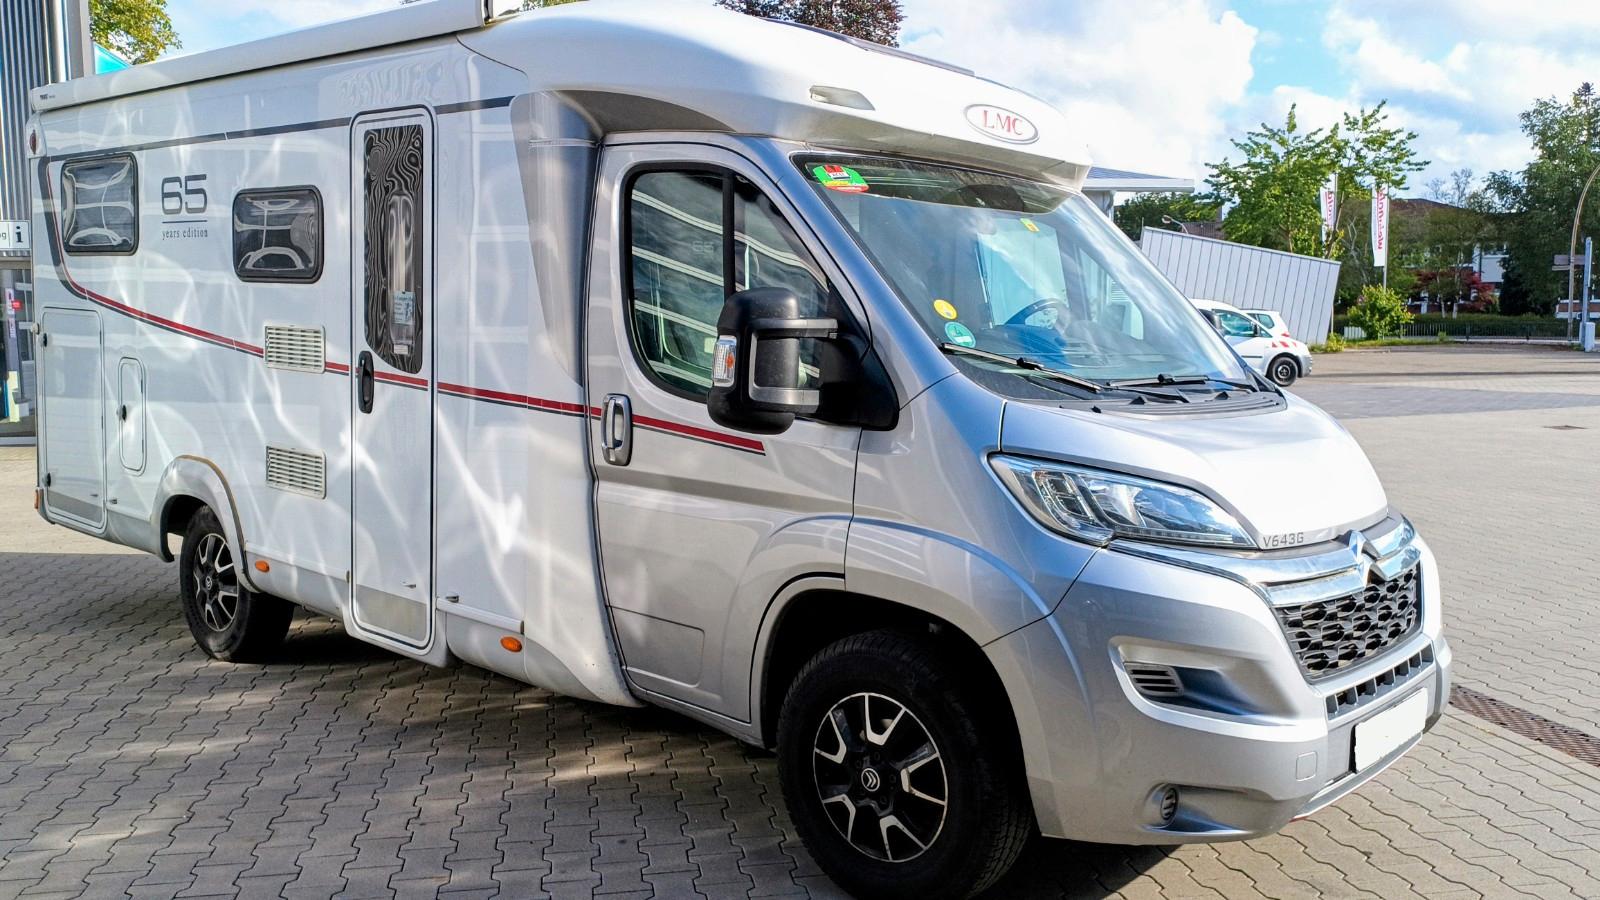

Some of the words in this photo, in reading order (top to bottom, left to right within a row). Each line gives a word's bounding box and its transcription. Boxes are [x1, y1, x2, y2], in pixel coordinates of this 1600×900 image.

[983, 109, 1023, 136] LMC
[161, 174, 208, 215] 65
[162, 229, 180, 241] years
[182, 227, 208, 238] edition
[1263, 531, 1304, 547] V643G
